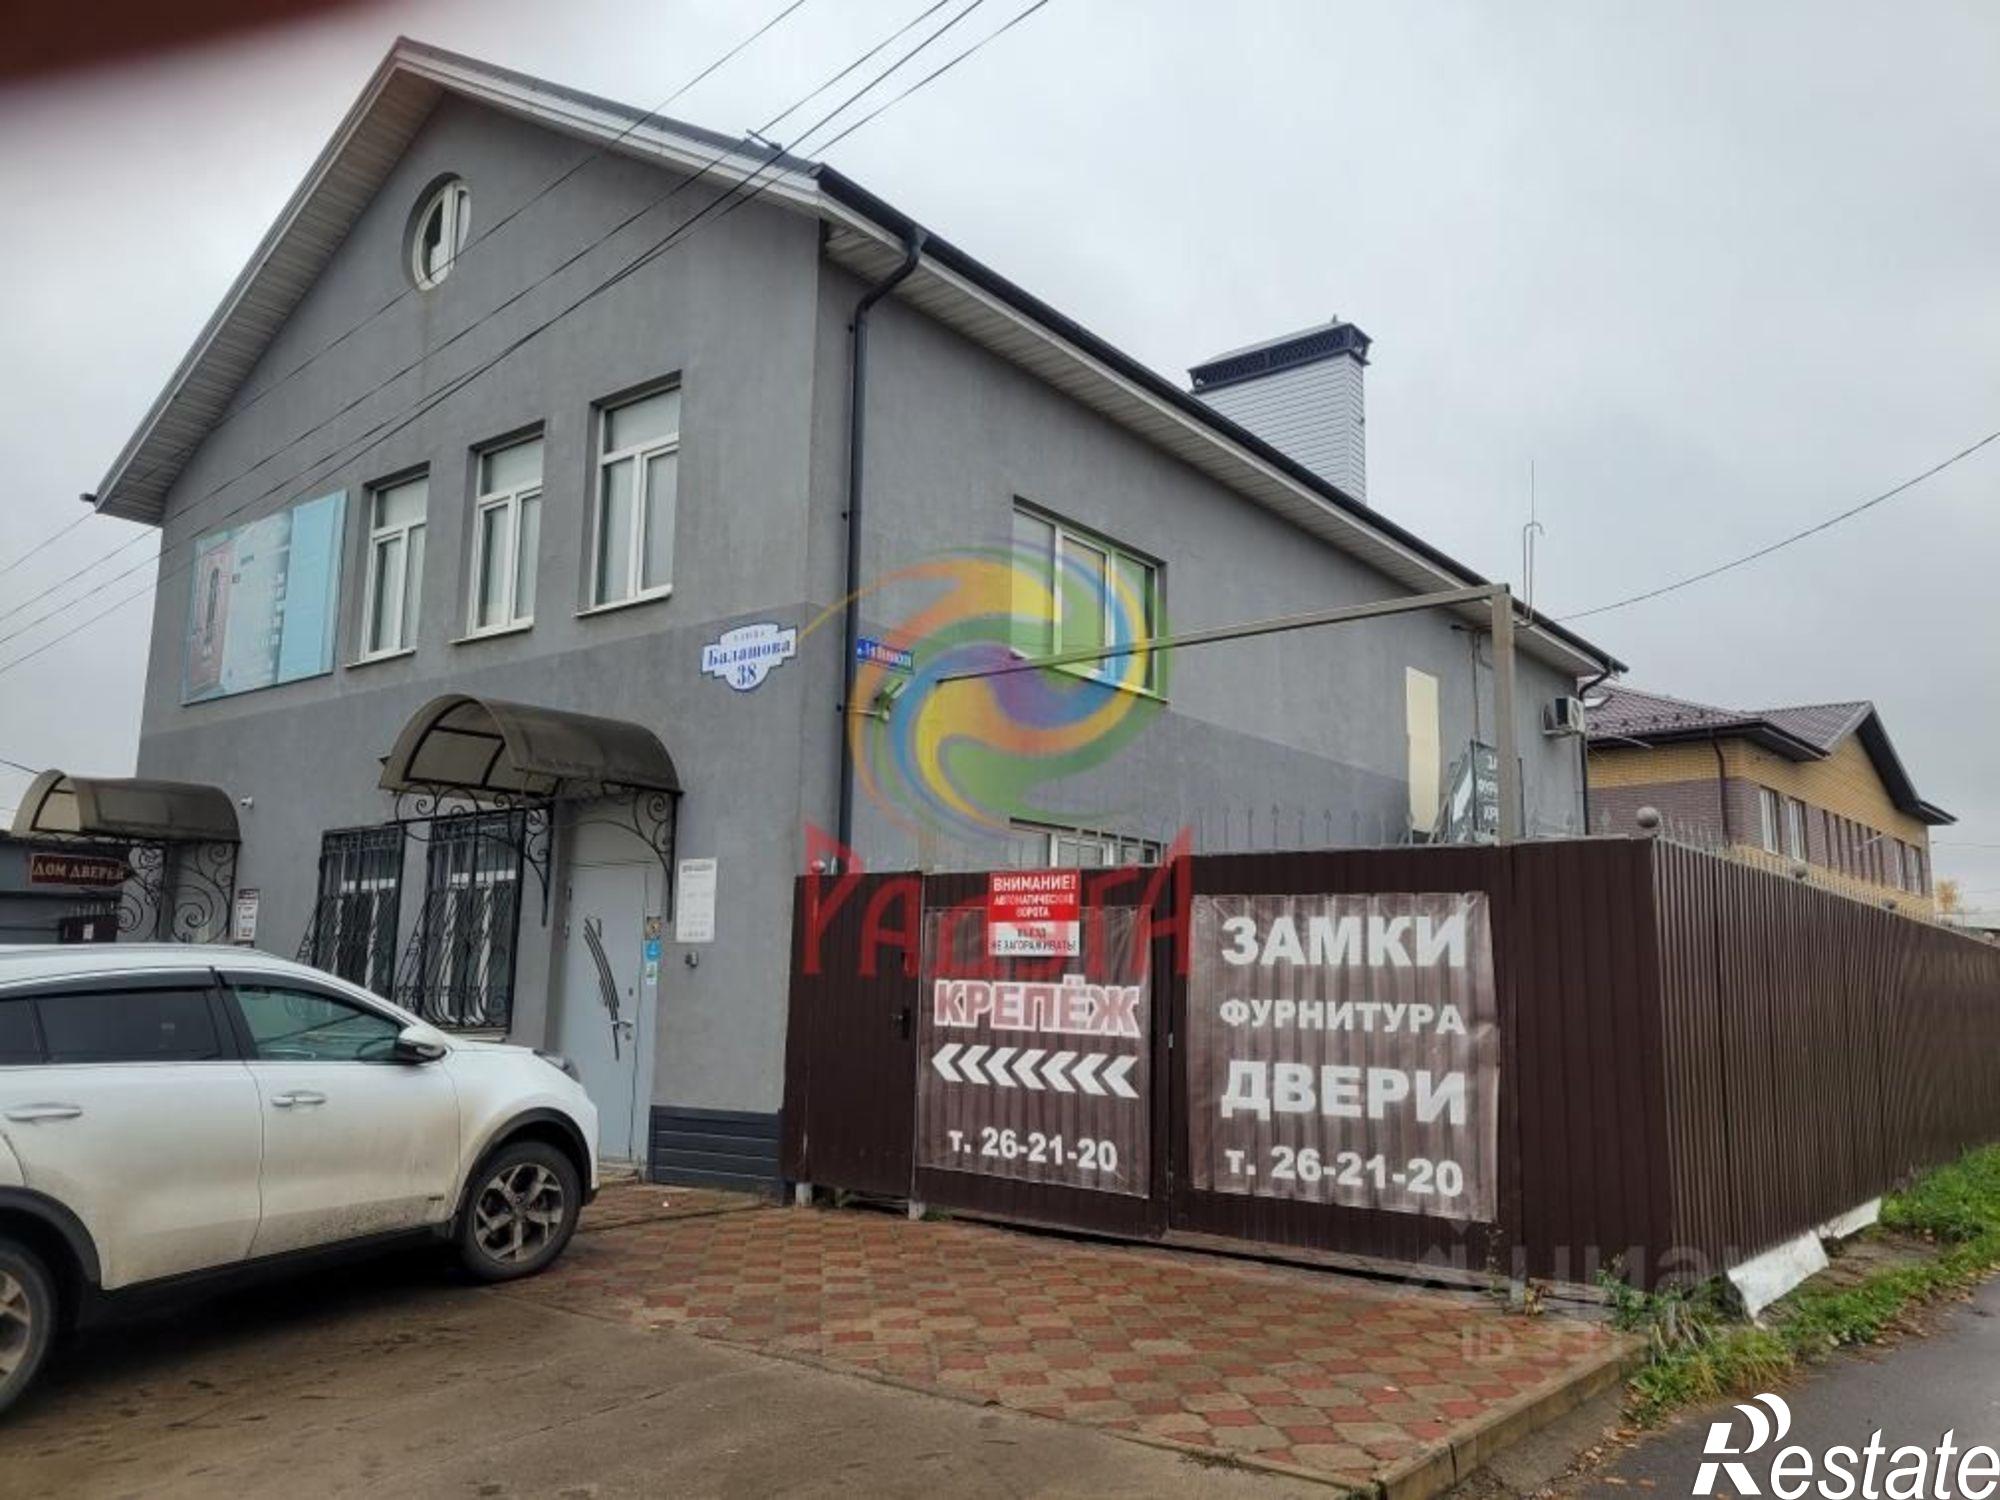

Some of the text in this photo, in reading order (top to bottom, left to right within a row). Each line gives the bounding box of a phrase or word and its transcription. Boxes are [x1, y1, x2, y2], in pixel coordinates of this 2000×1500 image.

[708, 640, 791, 667] Балашова
[738, 664, 757, 686] 38
[993, 875, 1077, 892] ВНИМАНИЕ!
[993, 893, 1075, 906] АВТОМАТИЧЕСКИЕ
[1015, 906, 1050, 918] ВОРОТА
[1221, 915, 1467, 968] ЗАМКИ
[933, 974, 1142, 1038] КРЕПЁЖ
[1219, 999, 1467, 1035] ФУРНИТУРА
[1220, 1060, 1466, 1126] ДВЕРИ
[981, 1126, 1118, 1172] 26-21-20
[1270, 1145, 1464, 1197] 26-21-20
